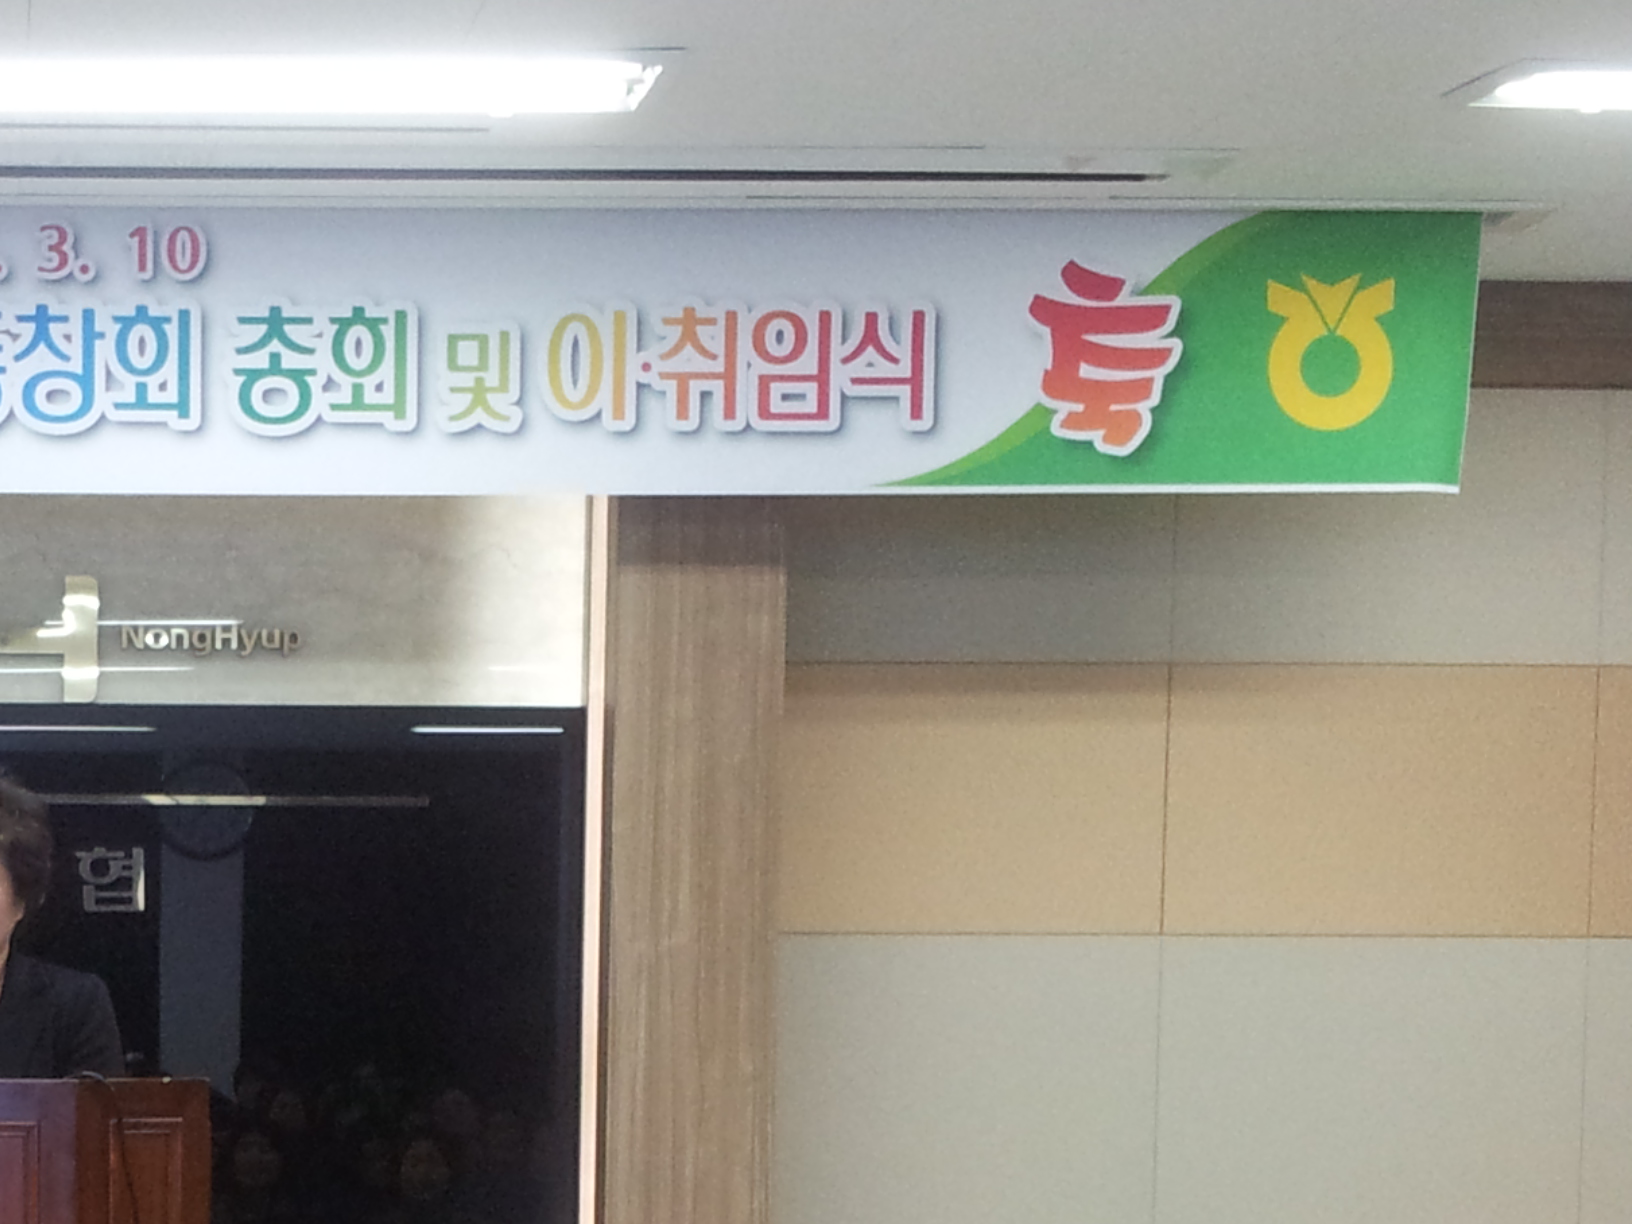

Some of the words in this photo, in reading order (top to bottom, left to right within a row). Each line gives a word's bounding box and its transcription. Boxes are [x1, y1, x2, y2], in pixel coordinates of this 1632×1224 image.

[36, 223, 92, 277] 3.
[127, 224, 202, 275] 10
[231, 304, 409, 426] 총회
[446, 329, 512, 423] 및
[120, 622, 303, 657] NongHyup
